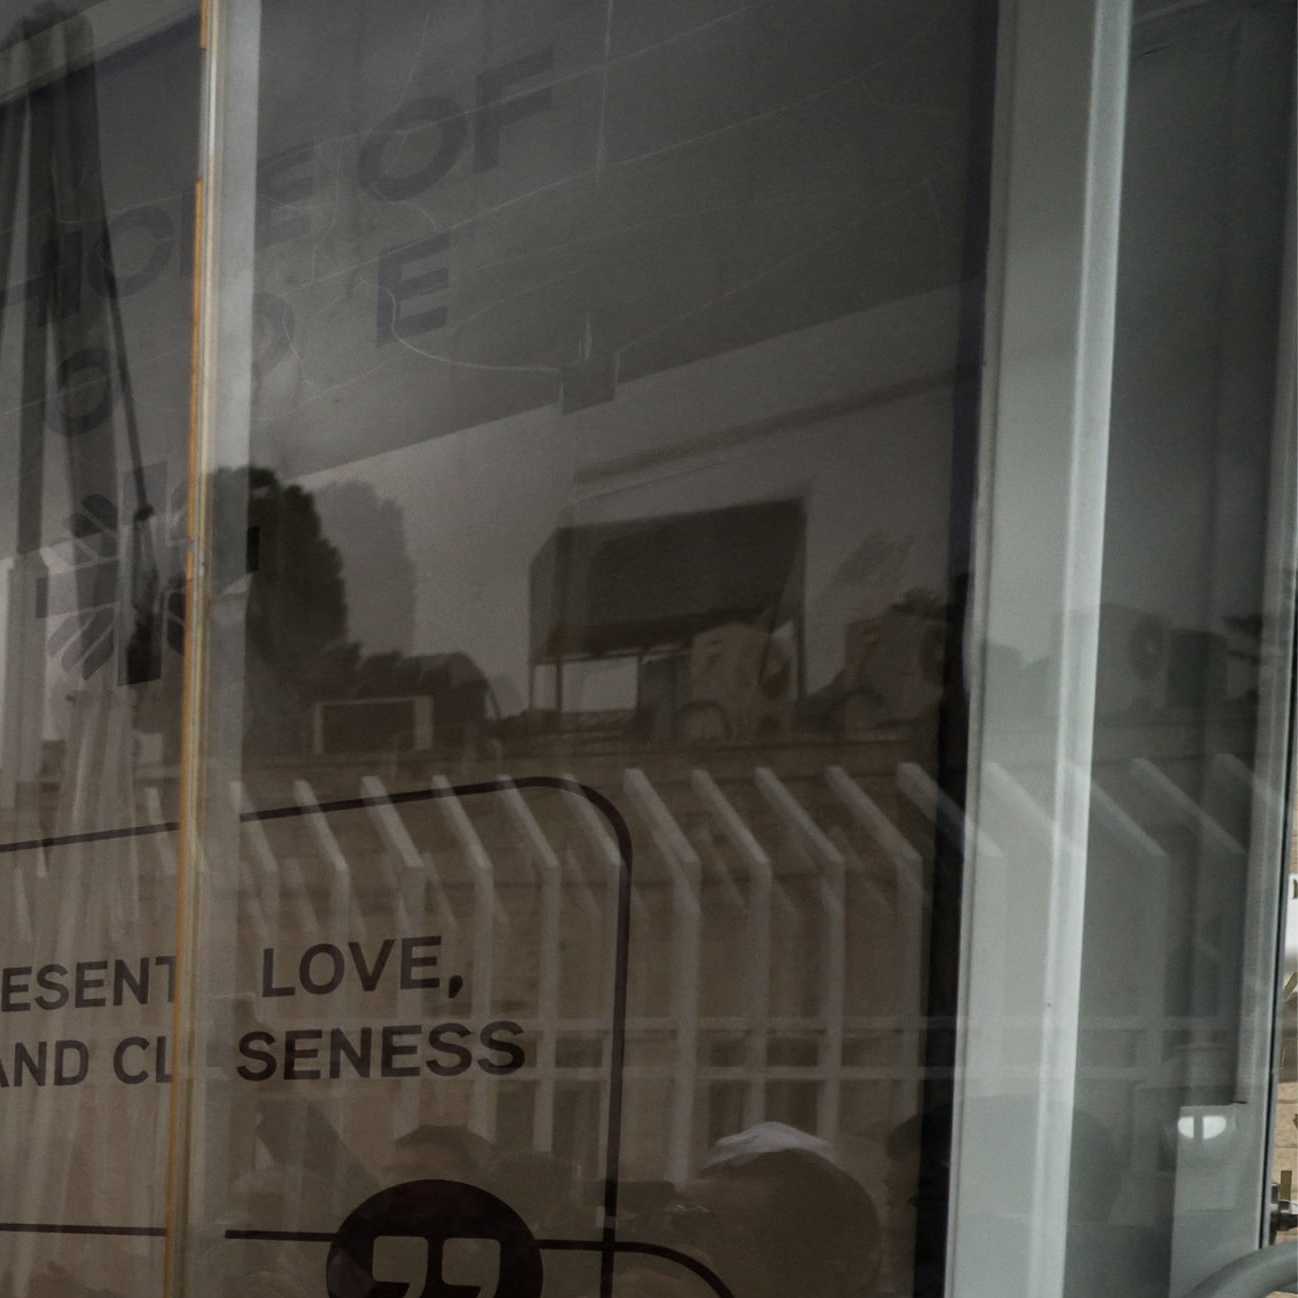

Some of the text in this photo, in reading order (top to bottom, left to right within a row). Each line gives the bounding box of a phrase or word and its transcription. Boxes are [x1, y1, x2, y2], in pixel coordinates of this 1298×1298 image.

[355, 45, 554, 203] OF
[262, 934, 466, 998] LOVE,
[113, 1019, 526, 1085] CLSENESS
